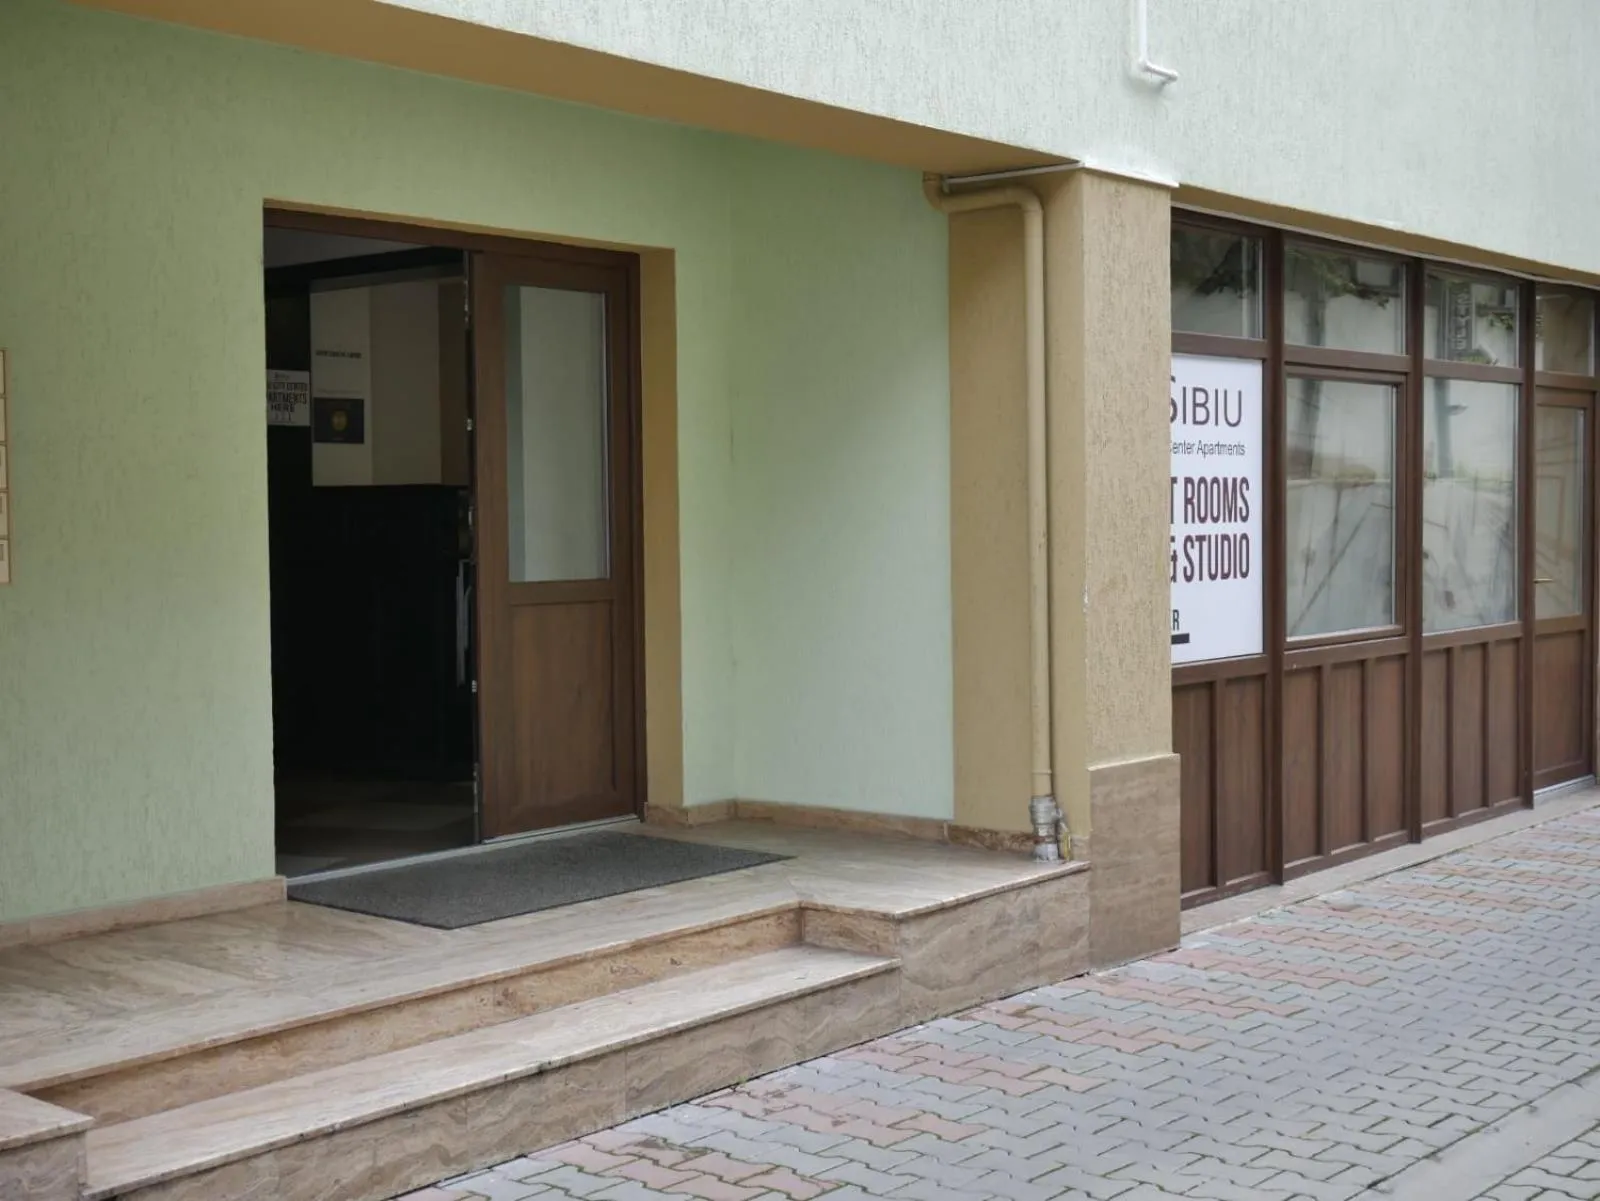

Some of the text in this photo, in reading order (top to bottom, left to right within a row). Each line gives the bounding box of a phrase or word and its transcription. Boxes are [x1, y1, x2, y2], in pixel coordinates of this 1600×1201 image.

[1170, 440, 1246, 458] enter Apartments
[1183, 476, 1250, 524] ROOMS
[1183, 533, 1250, 583] STUDIO
